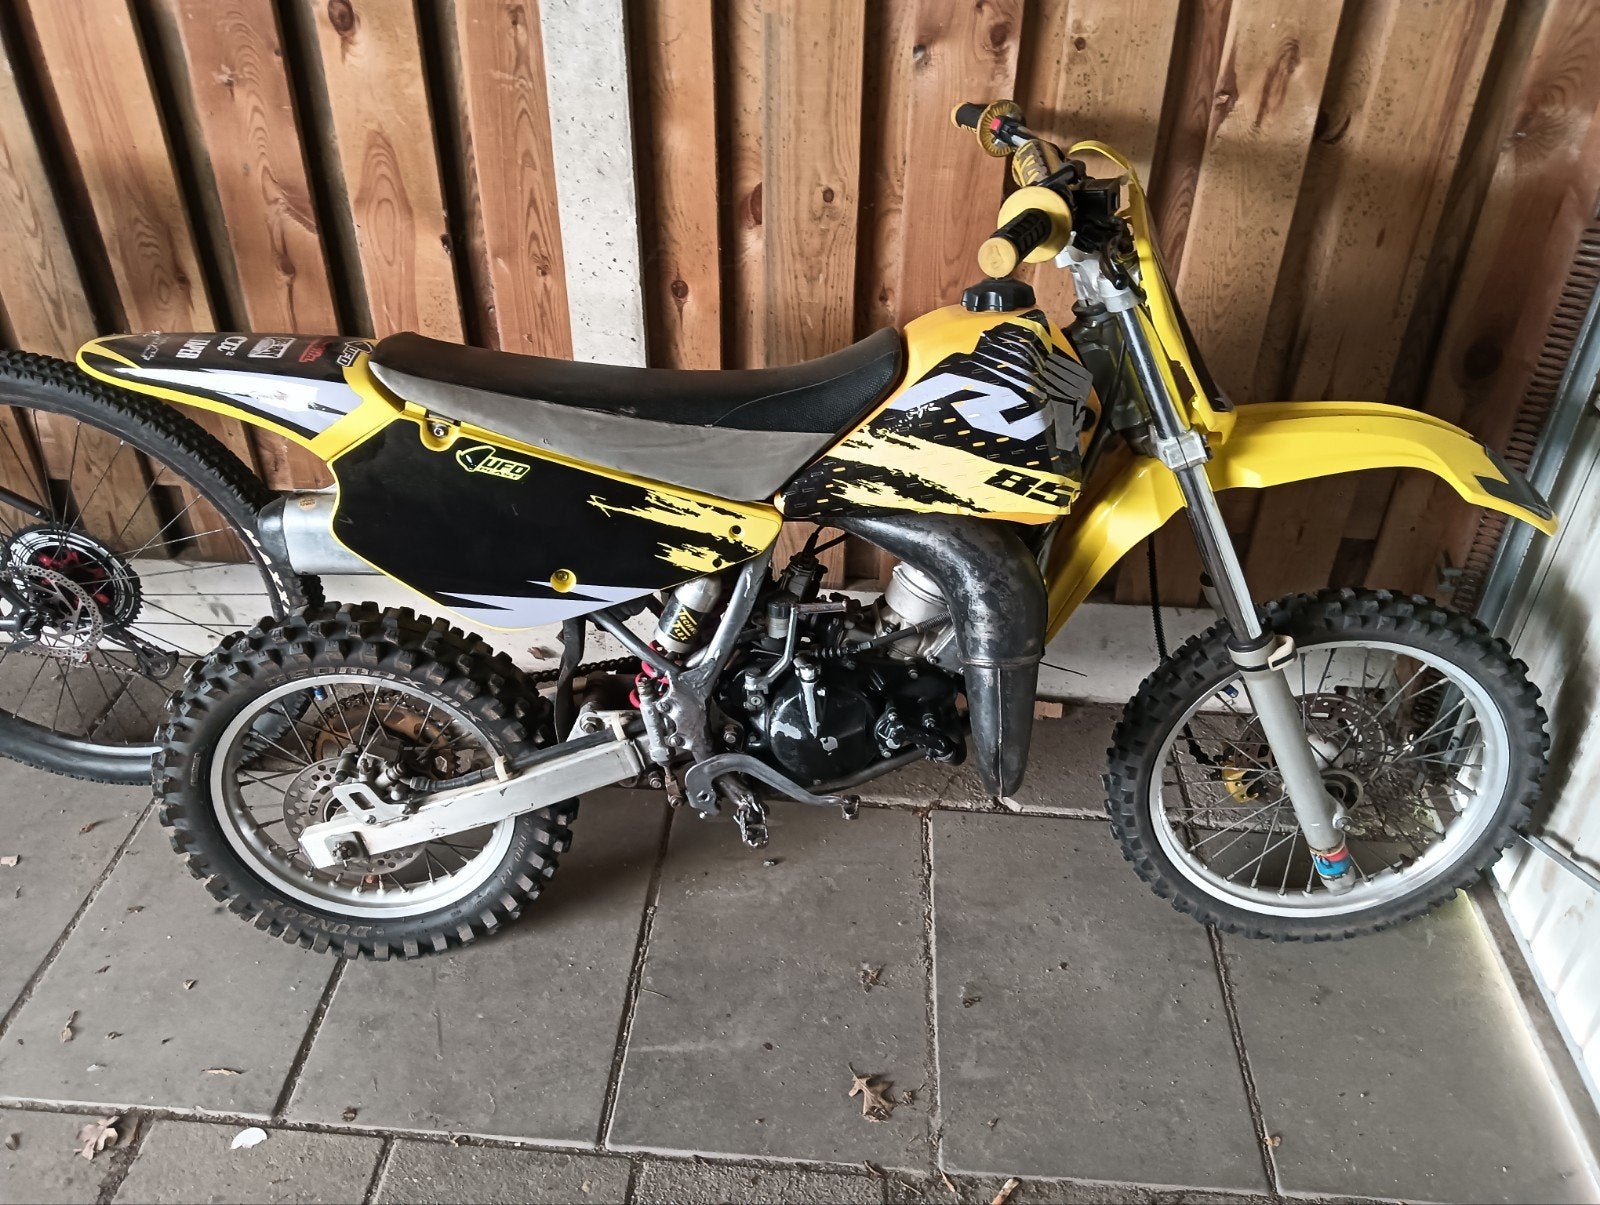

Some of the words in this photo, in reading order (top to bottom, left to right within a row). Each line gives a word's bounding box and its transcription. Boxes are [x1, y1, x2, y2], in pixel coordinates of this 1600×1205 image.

[337, 346, 359, 367] UFO
[481, 457, 529, 476] UFO
[984, 467, 1075, 507] 85
[241, 527, 291, 615] MAXXI
